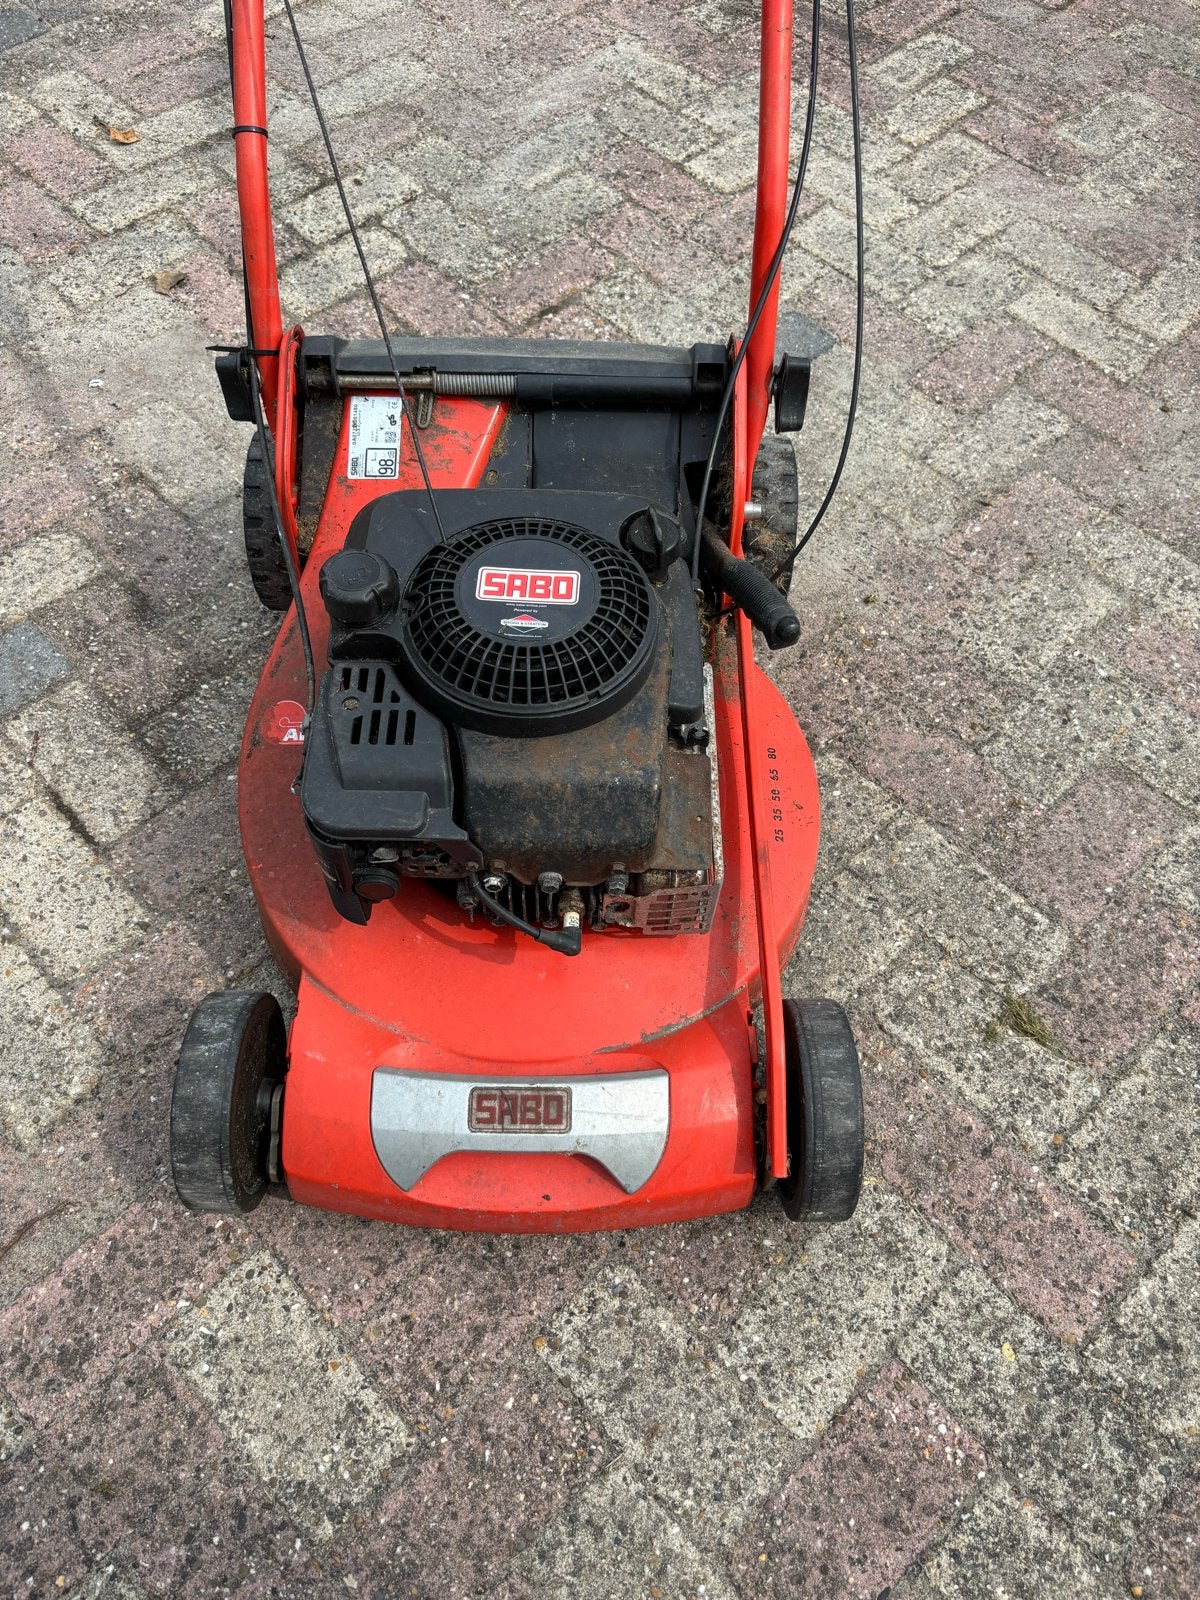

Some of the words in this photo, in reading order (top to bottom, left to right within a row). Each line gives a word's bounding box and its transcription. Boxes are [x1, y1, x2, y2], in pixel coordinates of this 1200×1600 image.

[378, 459, 394, 474] 98
[484, 572, 573, 600] SABO
[767, 748, 776, 760] 80
[769, 768, 779, 781] 65
[770, 789, 780, 802] 50
[772, 808, 782, 822] 35
[774, 829, 784, 842] 25
[476, 1094, 564, 1125] SABO
